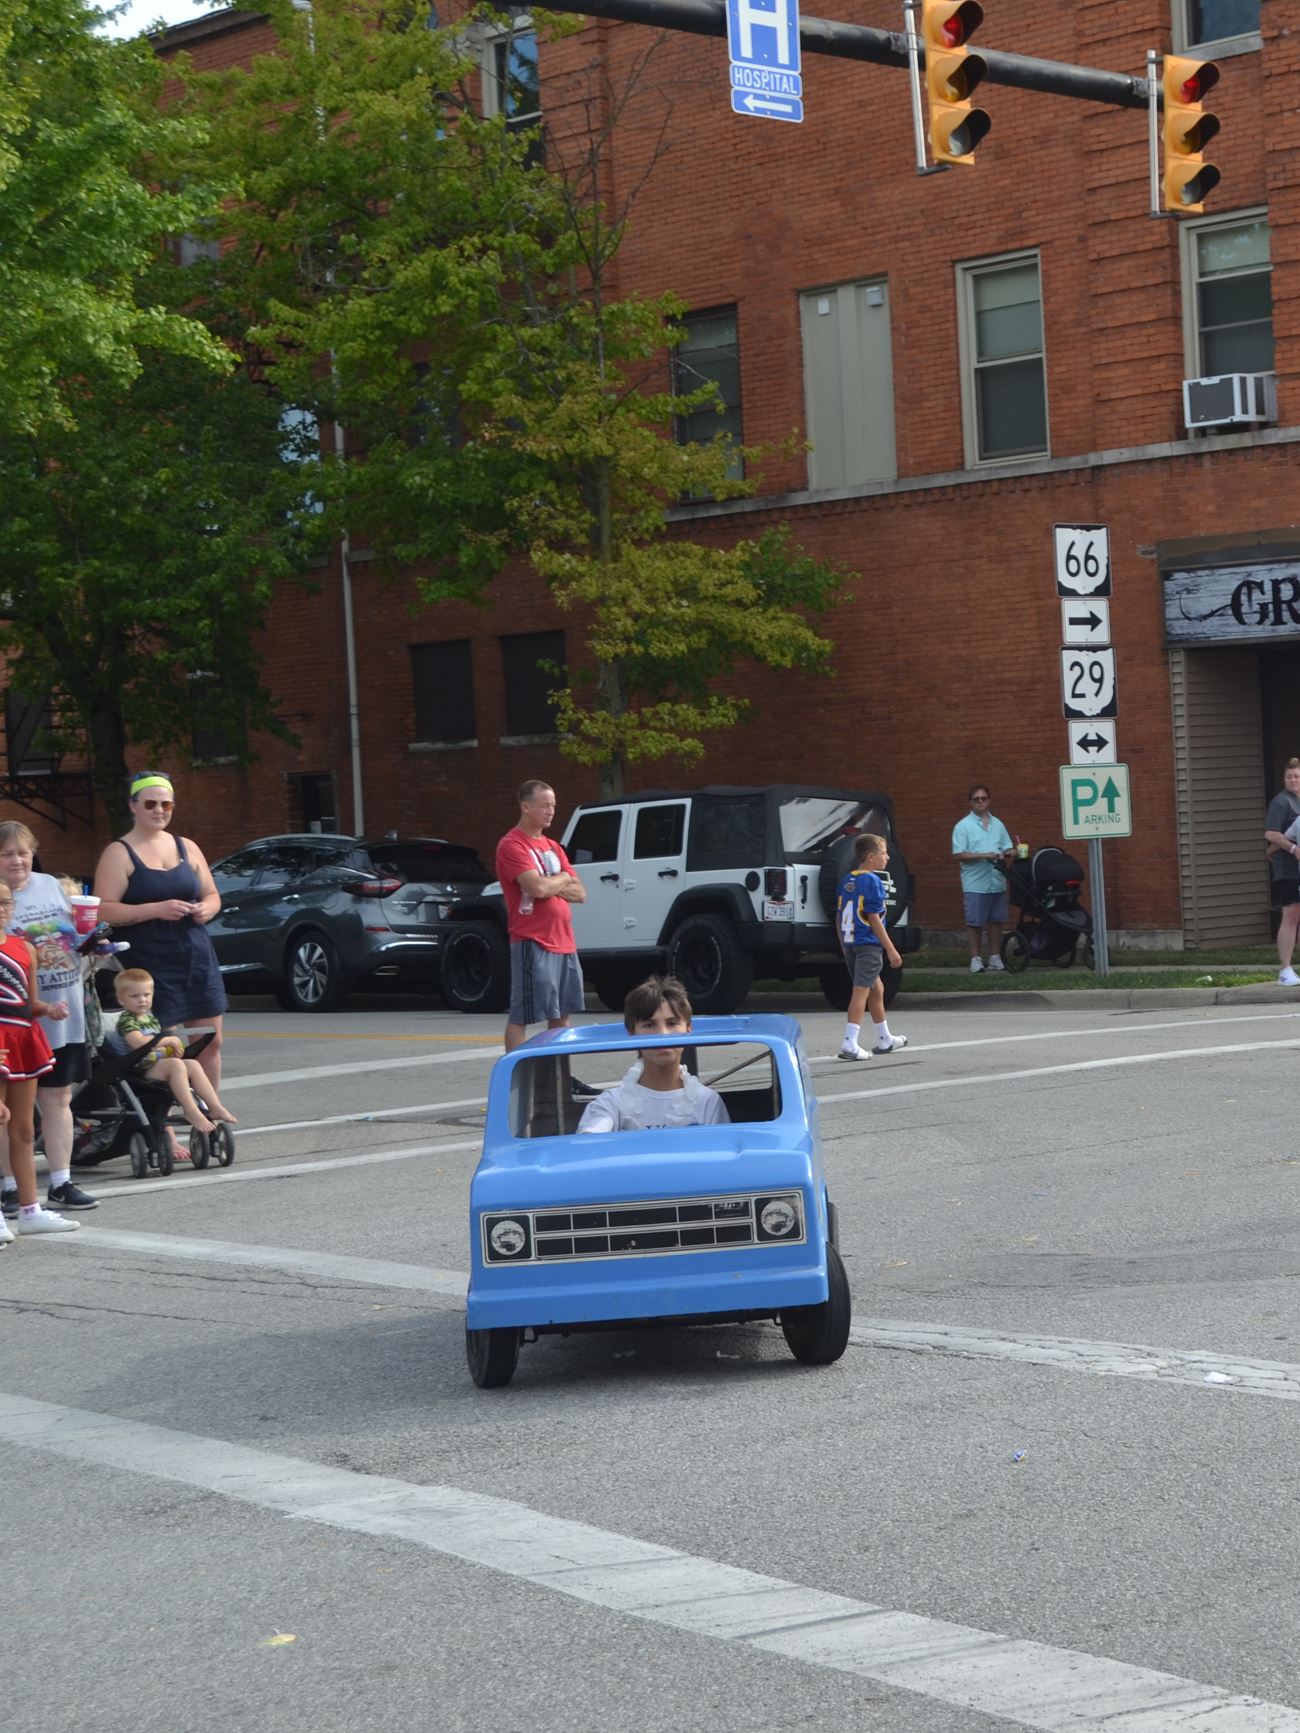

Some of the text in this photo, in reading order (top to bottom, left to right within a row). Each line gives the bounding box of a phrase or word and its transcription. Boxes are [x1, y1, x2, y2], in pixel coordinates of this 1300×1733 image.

[738, 0, 789, 65] H
[734, 66, 798, 94] HOSPITAL
[1065, 541, 1099, 577] 66
[1069, 661, 1104, 699] 29
